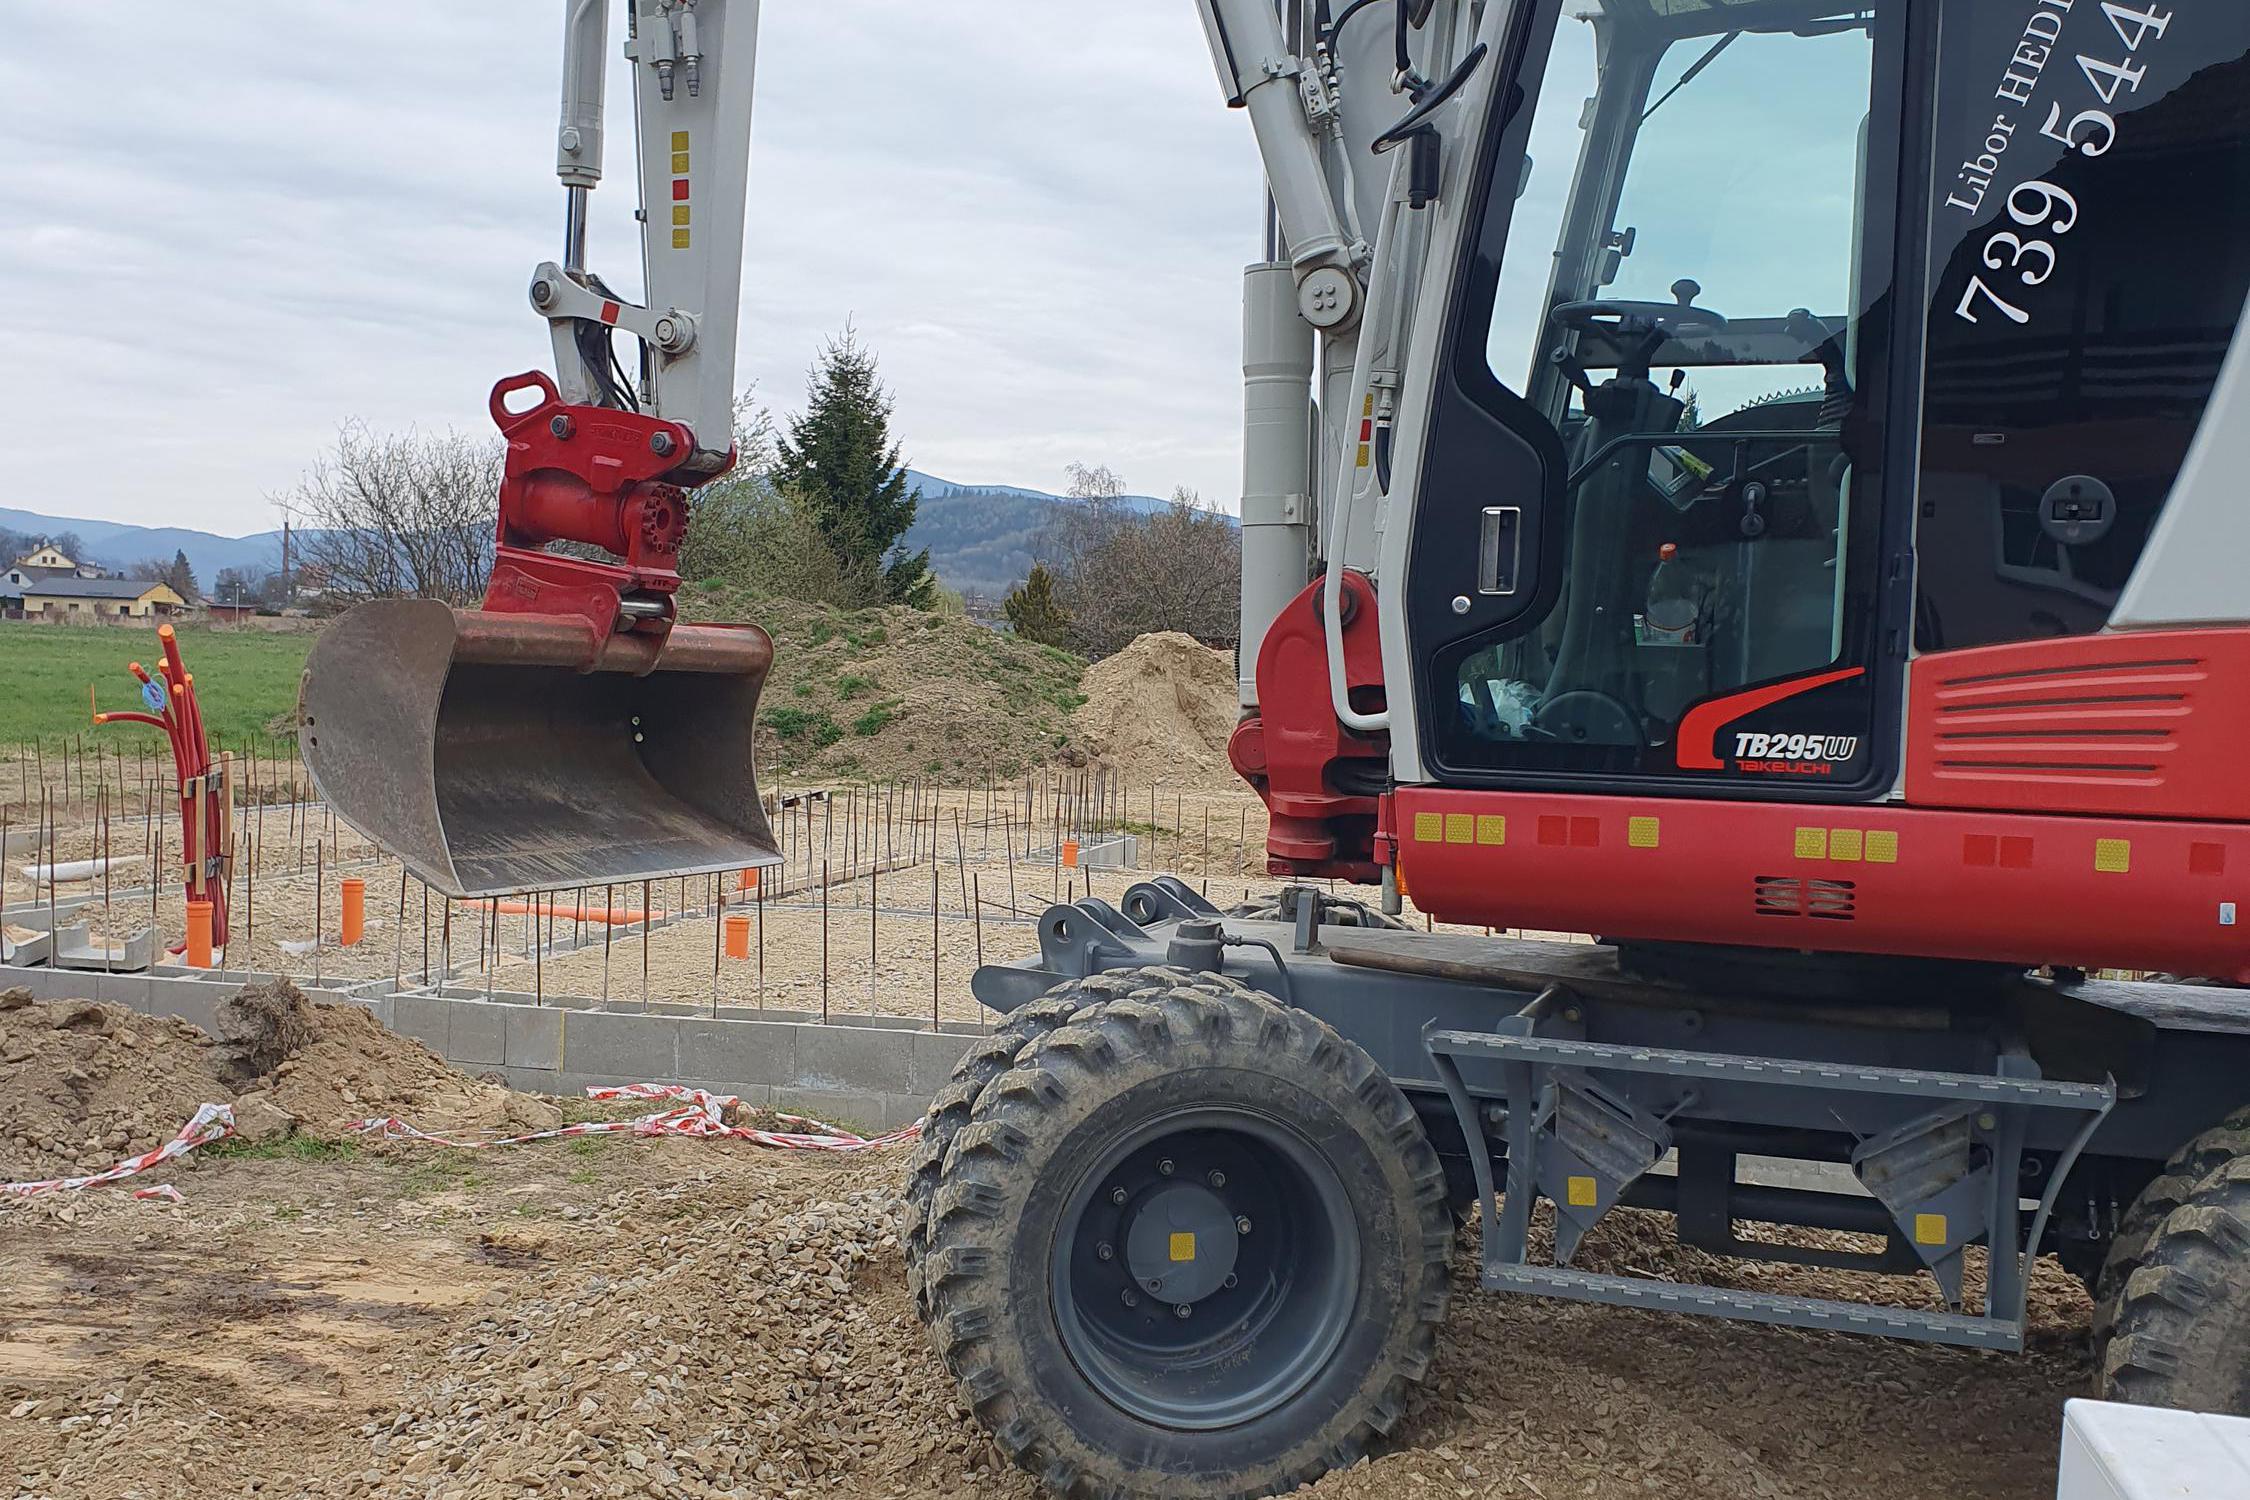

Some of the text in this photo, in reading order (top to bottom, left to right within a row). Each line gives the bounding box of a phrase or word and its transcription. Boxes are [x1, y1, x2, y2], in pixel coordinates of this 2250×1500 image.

[1945, 114, 2016, 216] Libor
[1955, 2, 2173, 324] 739 544
[1735, 732, 1858, 761] TB295W
[1736, 760, 1832, 775] TAKEUCHI
